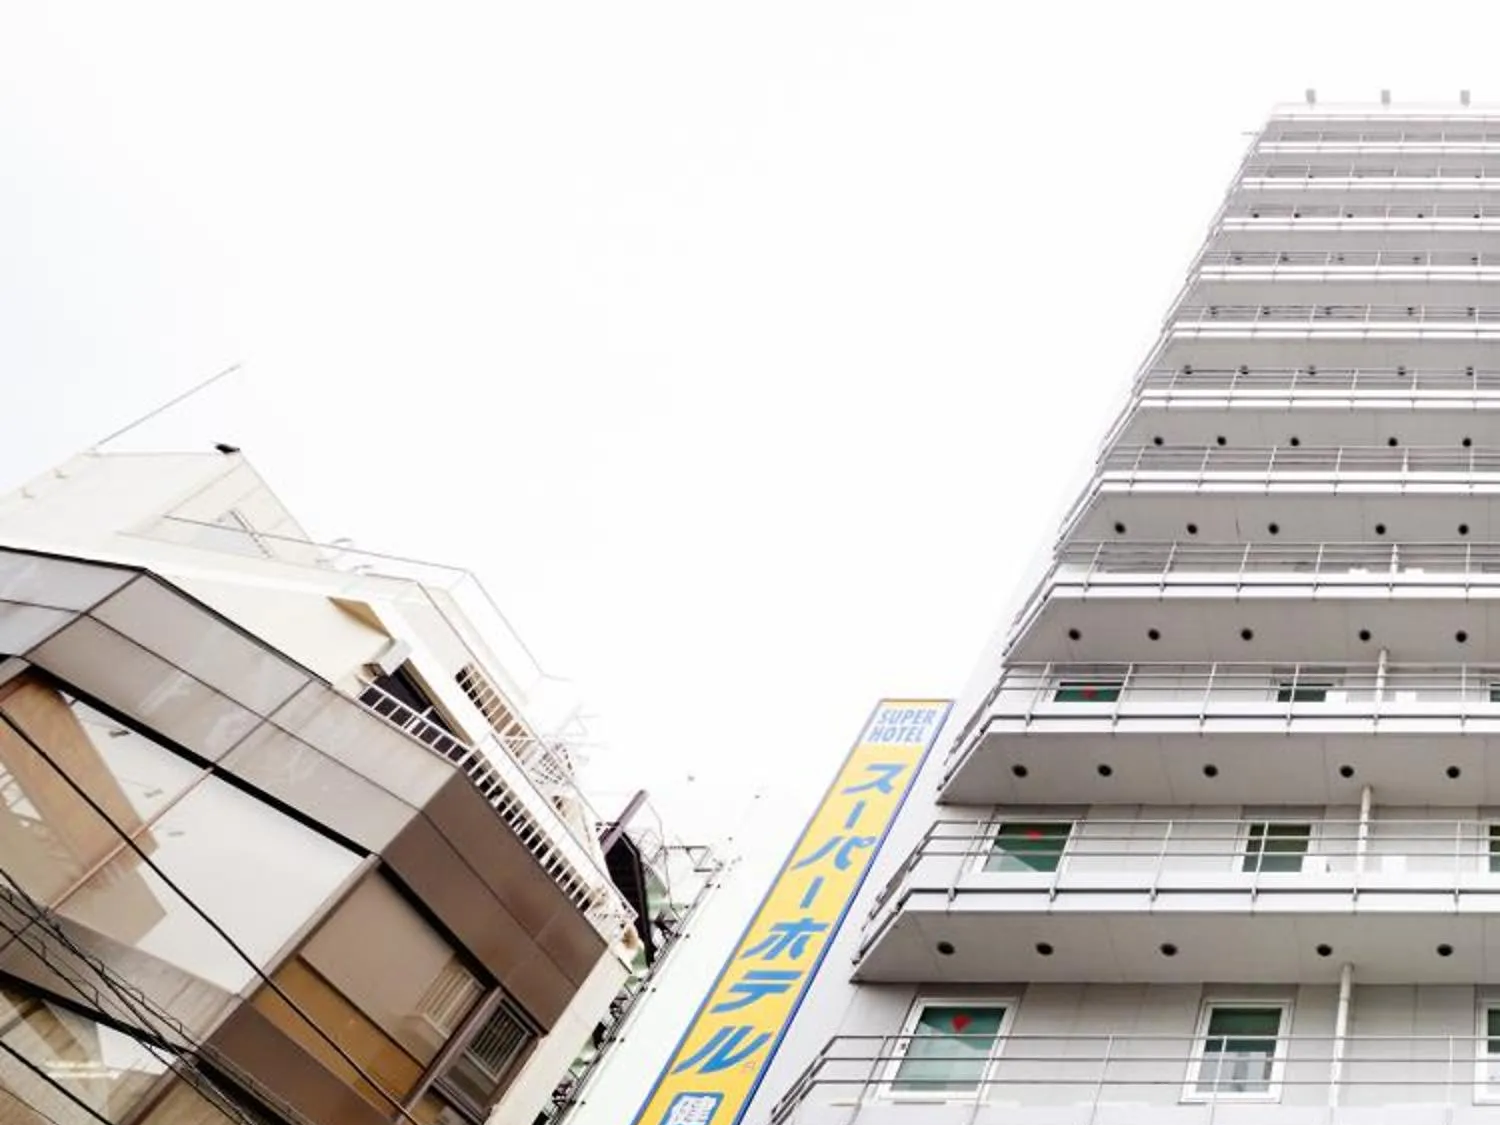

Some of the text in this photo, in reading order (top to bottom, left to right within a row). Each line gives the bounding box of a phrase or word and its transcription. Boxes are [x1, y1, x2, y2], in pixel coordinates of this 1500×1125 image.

[877, 708, 937, 725] SUPER
[867, 726, 926, 743] HOTEL
[672, 761, 909, 1076] スーパーホテル
